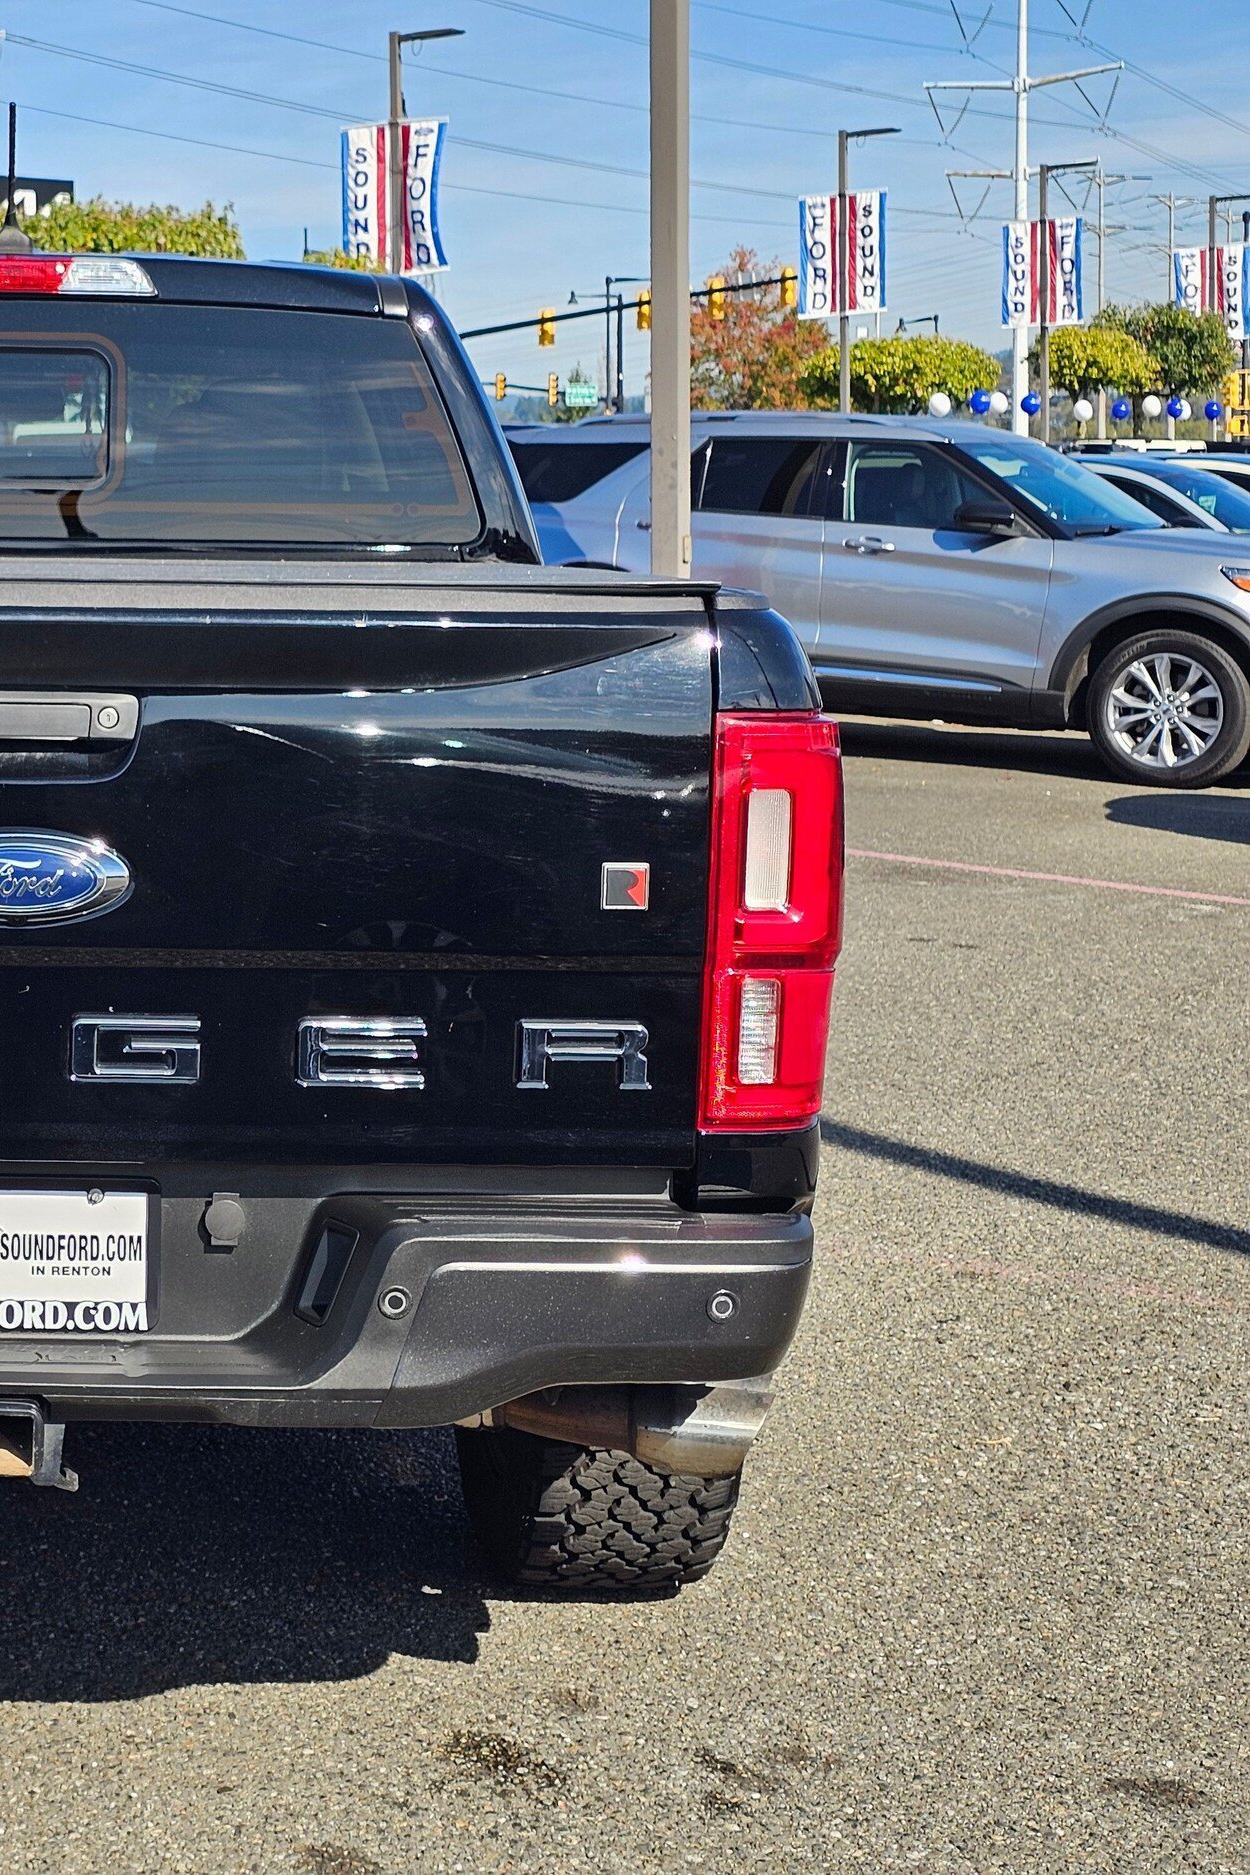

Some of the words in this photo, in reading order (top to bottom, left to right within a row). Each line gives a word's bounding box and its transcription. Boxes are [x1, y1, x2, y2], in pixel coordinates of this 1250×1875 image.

[409, 144, 431, 265] FORD
[810, 215, 827, 310] FORD
[861, 204, 875, 297] SOUND
[1014, 236, 1026, 313] SOUND
[1061, 235, 1075, 319] FORD
[1227, 256, 1239, 329] SOUND
[0, 1233, 143, 1263] SOUNDFORD.COM
[31, 1265, 45, 1276] IN
[51, 1265, 111, 1277] RENTON
